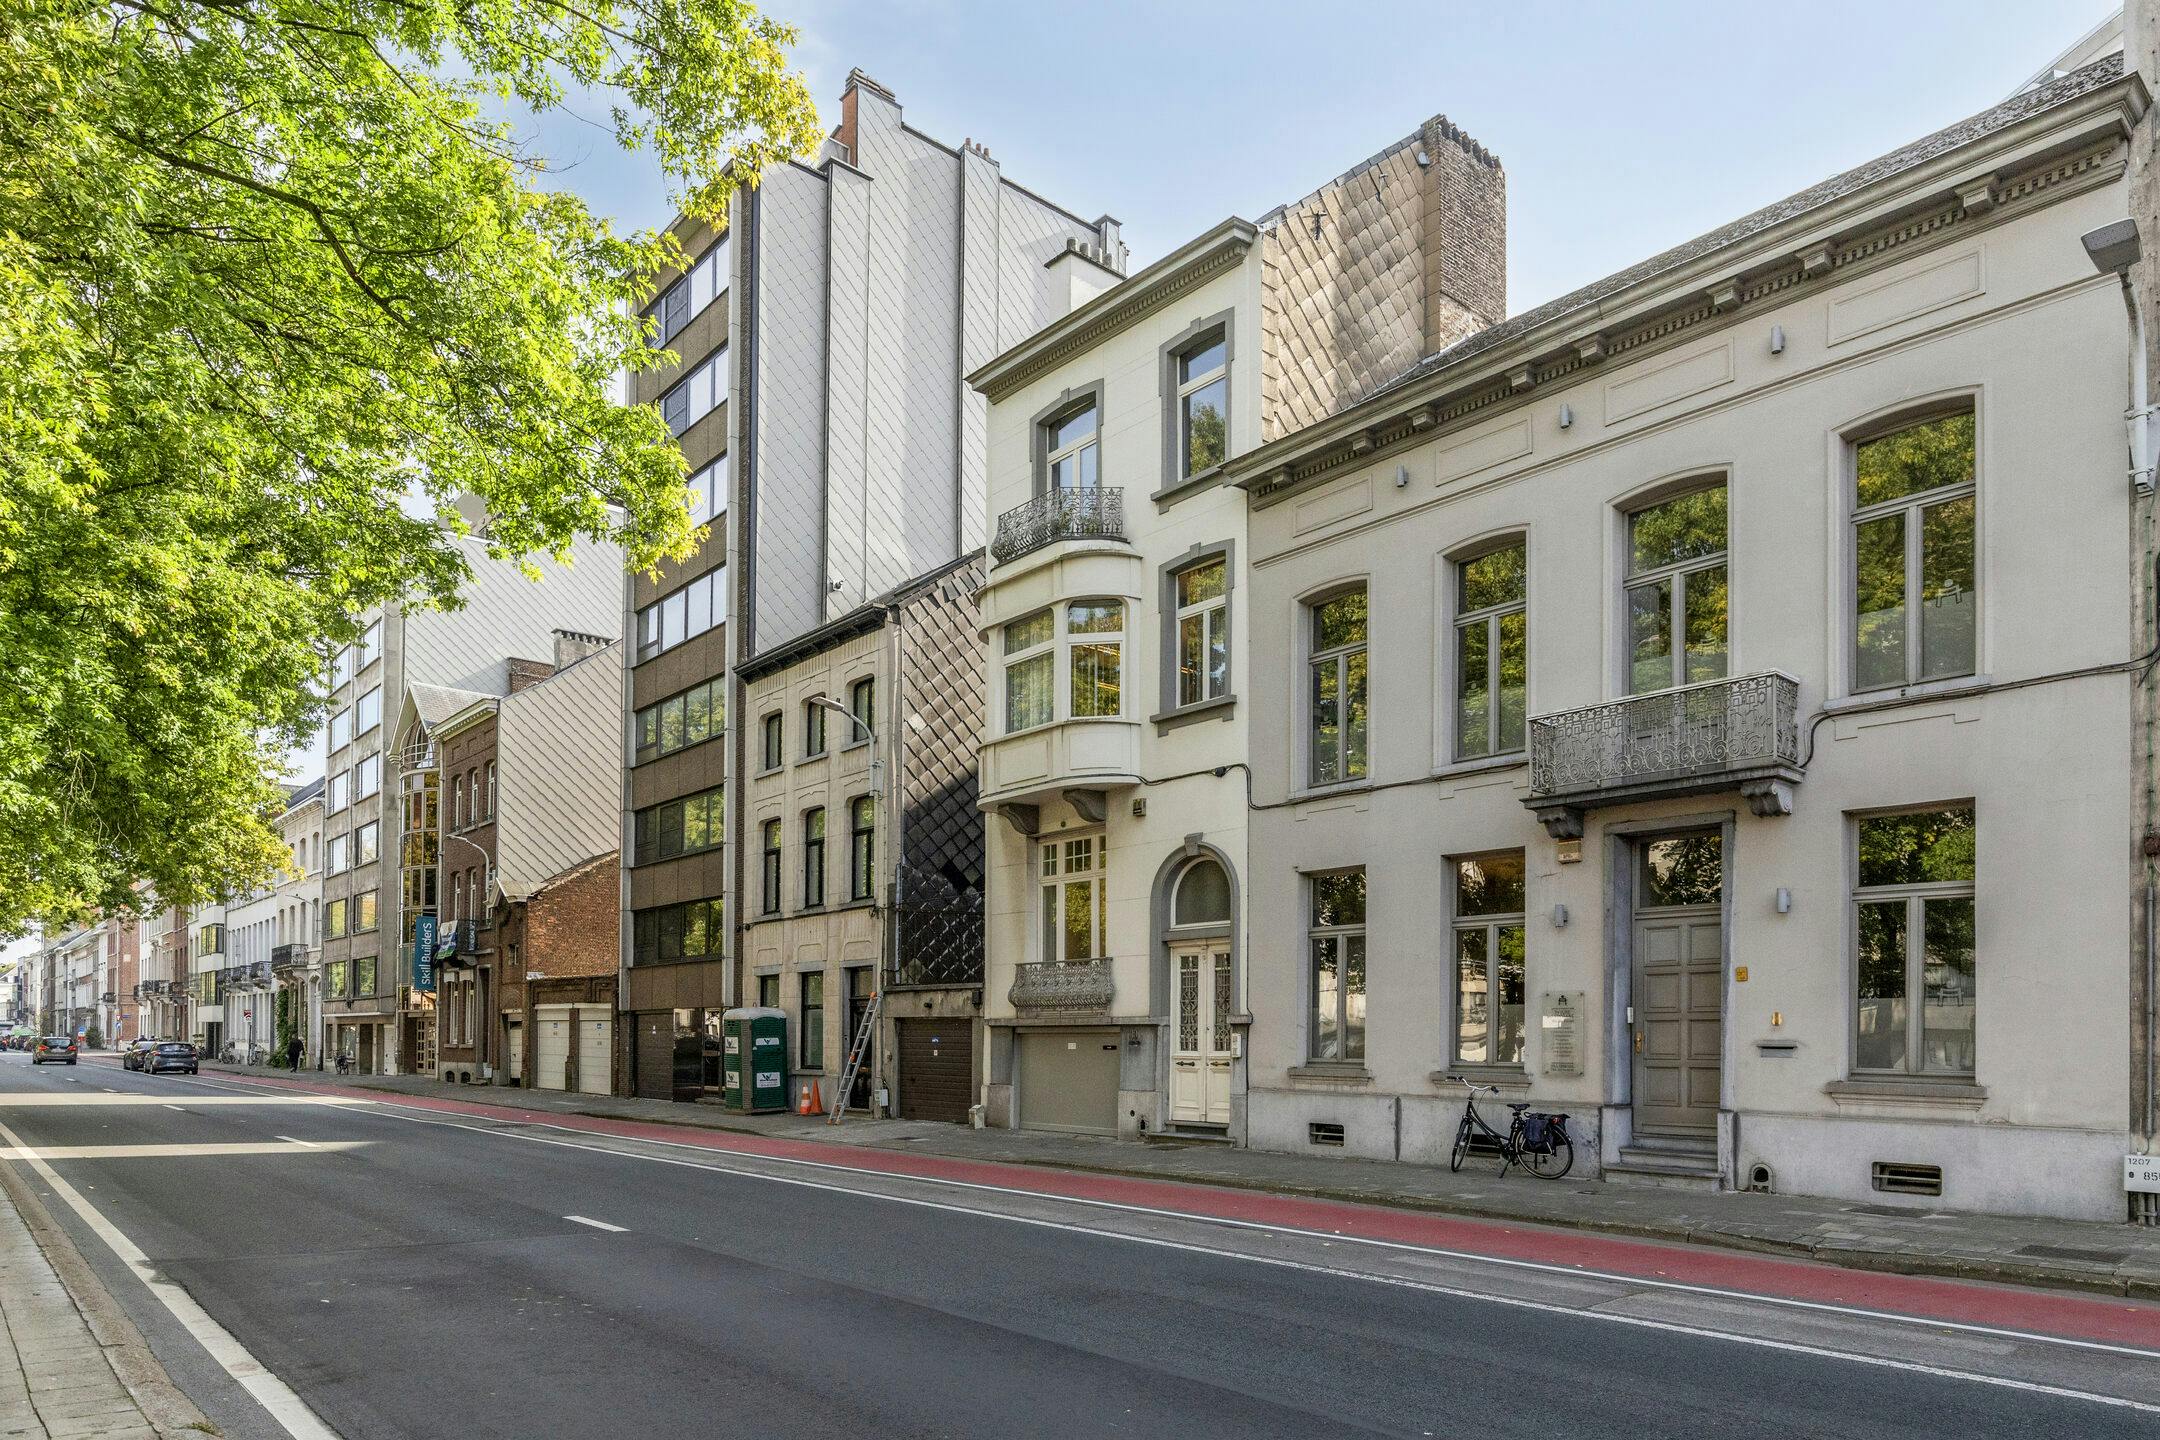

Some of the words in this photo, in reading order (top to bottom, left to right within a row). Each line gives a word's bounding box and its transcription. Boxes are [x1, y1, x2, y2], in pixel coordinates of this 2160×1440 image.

[421, 922, 432, 963] Builders
[419, 964, 431, 985] Skill
[2128, 1158, 2151, 1166] 1207
[2143, 1171, 2160, 1181] 85
